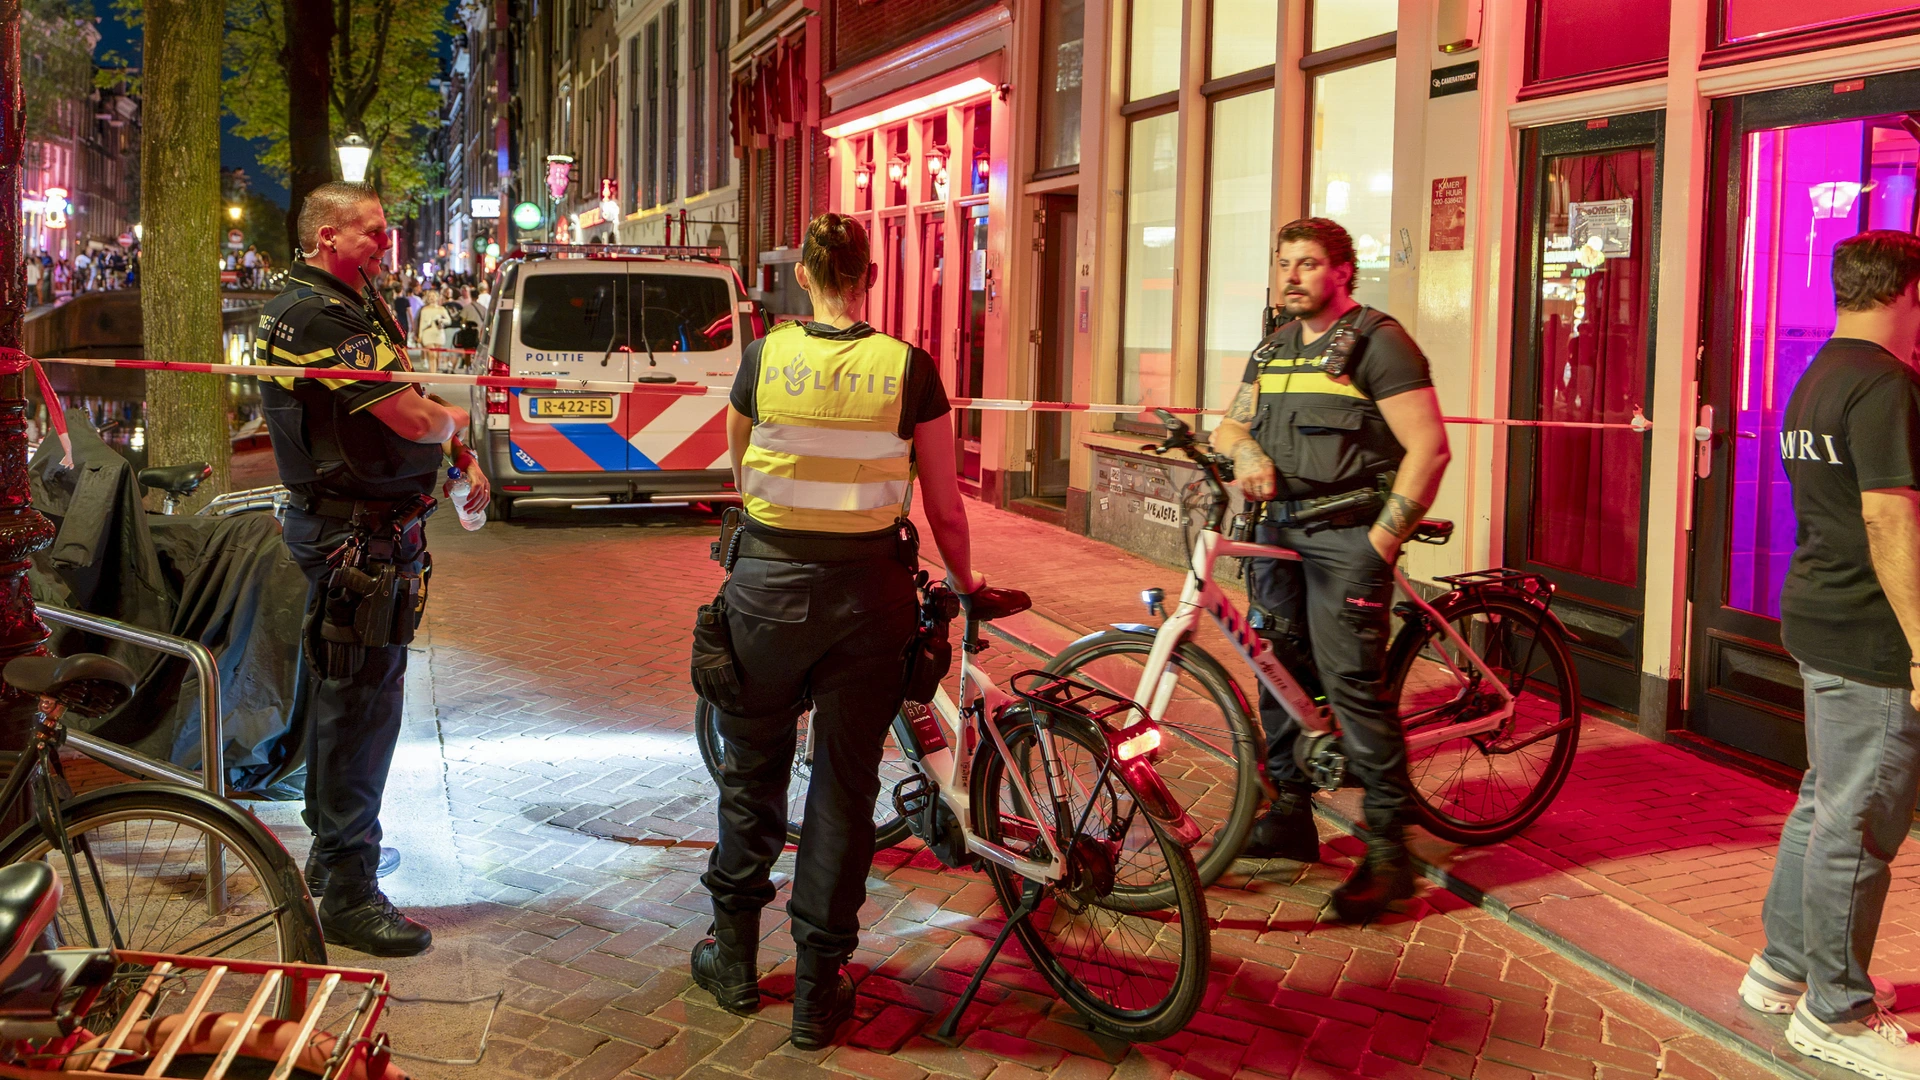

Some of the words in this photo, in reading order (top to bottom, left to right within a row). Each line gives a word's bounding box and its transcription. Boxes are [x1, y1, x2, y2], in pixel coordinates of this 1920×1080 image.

[1440, 72, 1477, 86] CAMERATOEZICHT
[1438, 180, 1460, 190] KAMER
[1435, 190, 1443, 198] TE
[1445, 188, 1463, 197] HUUR
[1081, 264, 1090, 277] 42
[341, 338, 369, 355] POLITIE
[525, 352, 584, 362] POLITIE
[764, 365, 897, 397] POLITIE
[543, 400, 607, 413] R-422-FS
[515, 449, 536, 467] 2325
